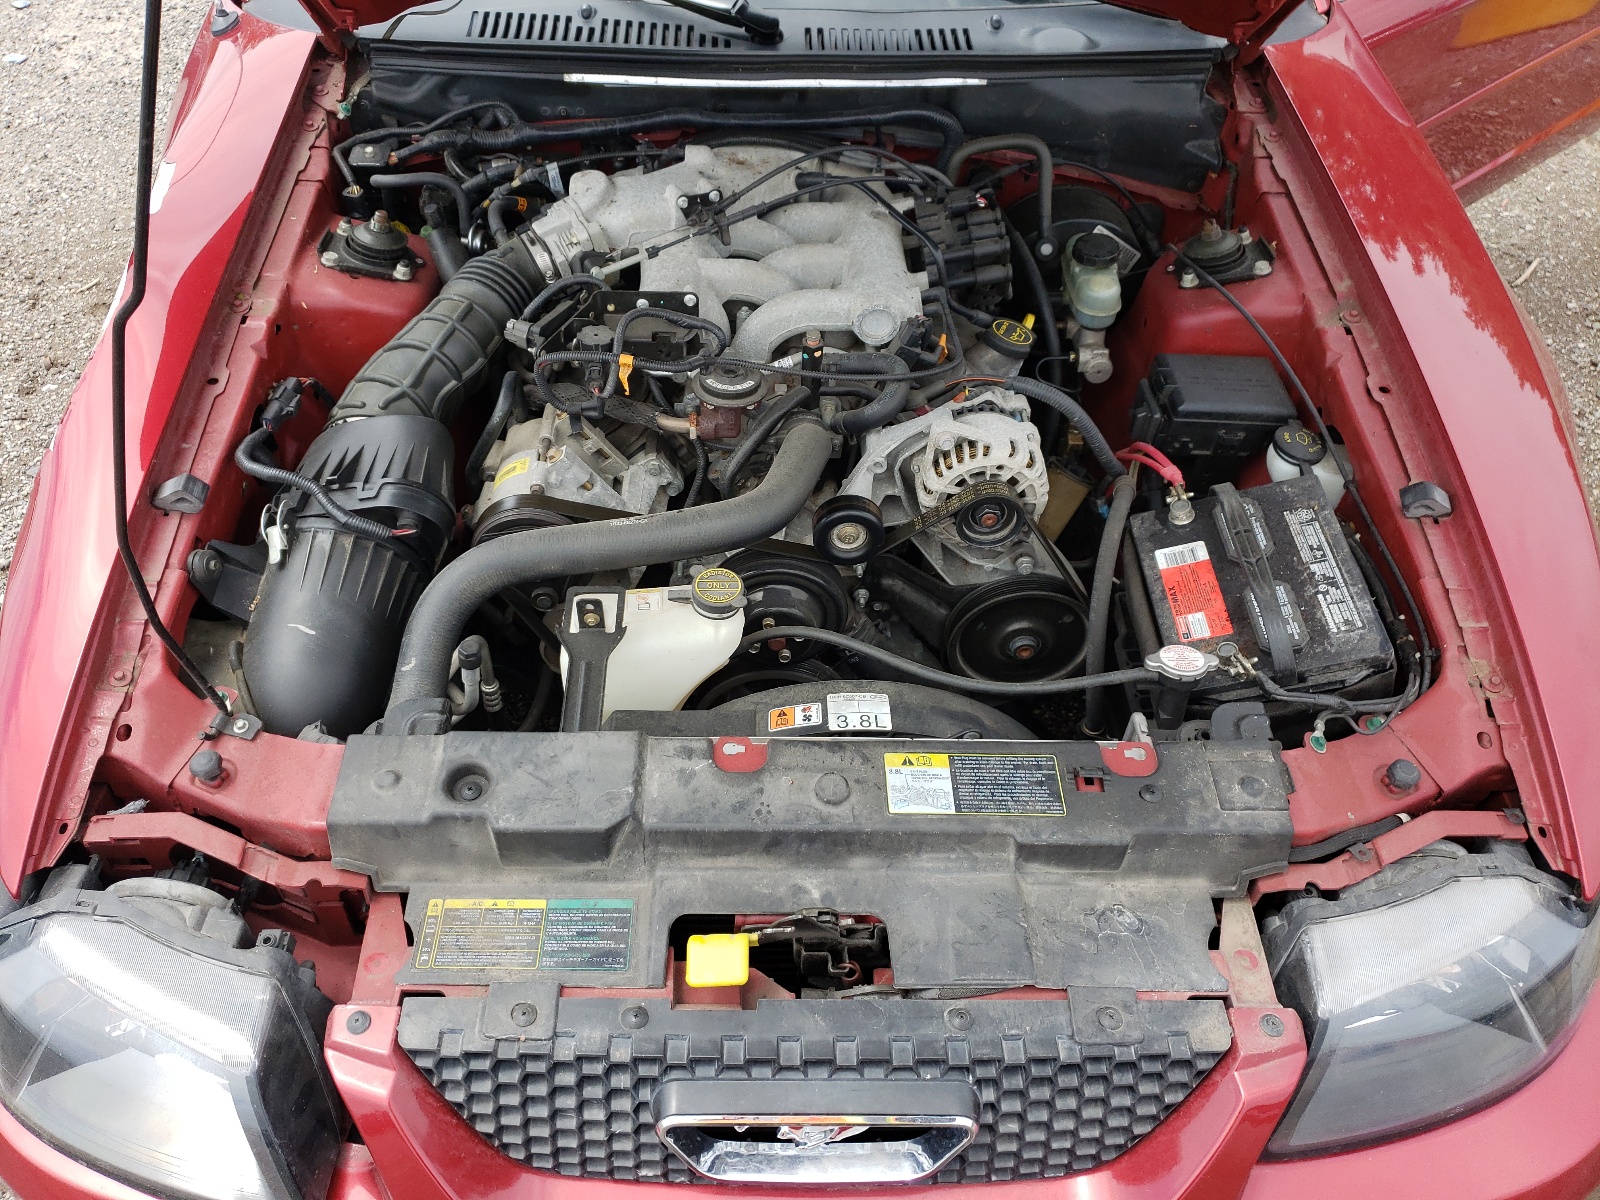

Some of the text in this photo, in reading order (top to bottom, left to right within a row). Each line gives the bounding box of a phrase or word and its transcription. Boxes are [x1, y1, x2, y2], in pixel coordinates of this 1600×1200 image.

[704, 592, 733, 601] COOLANT
[1168, 585, 1179, 604] MAX
[836, 714, 888, 729] 3.8L
